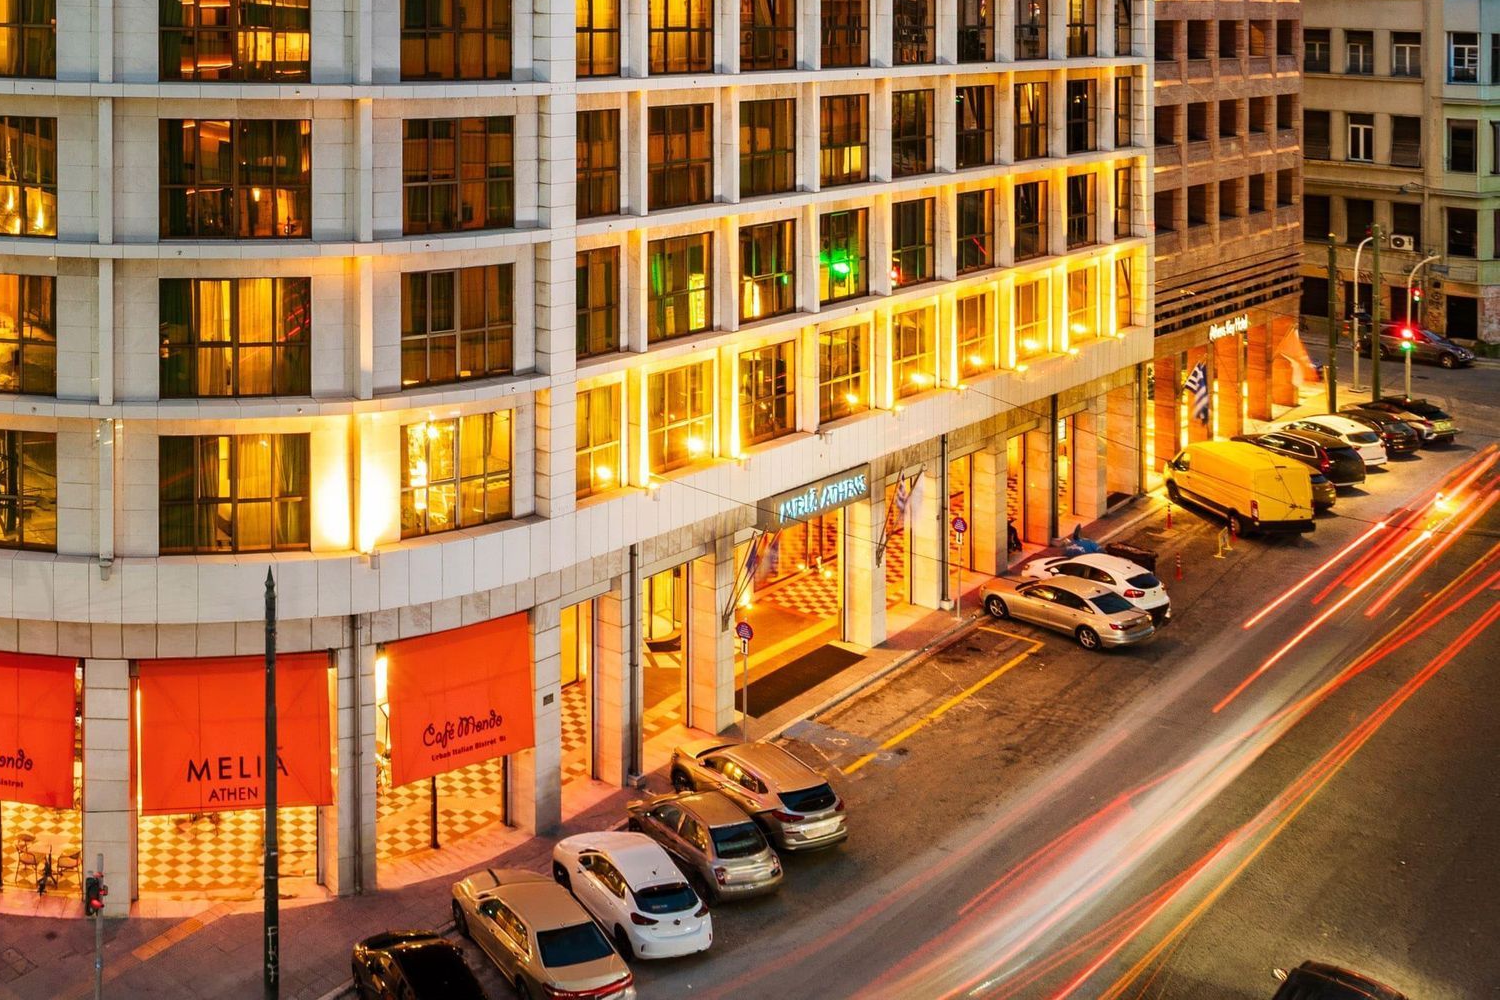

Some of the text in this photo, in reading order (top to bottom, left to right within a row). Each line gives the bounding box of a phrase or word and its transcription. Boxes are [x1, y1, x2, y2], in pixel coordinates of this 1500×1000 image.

[820, 473, 867, 508] ATHENS
[423, 709, 503, 749] Café Mondo
[452, 744, 474, 756] Italian
[208, 786, 259, 802] ATHEN
